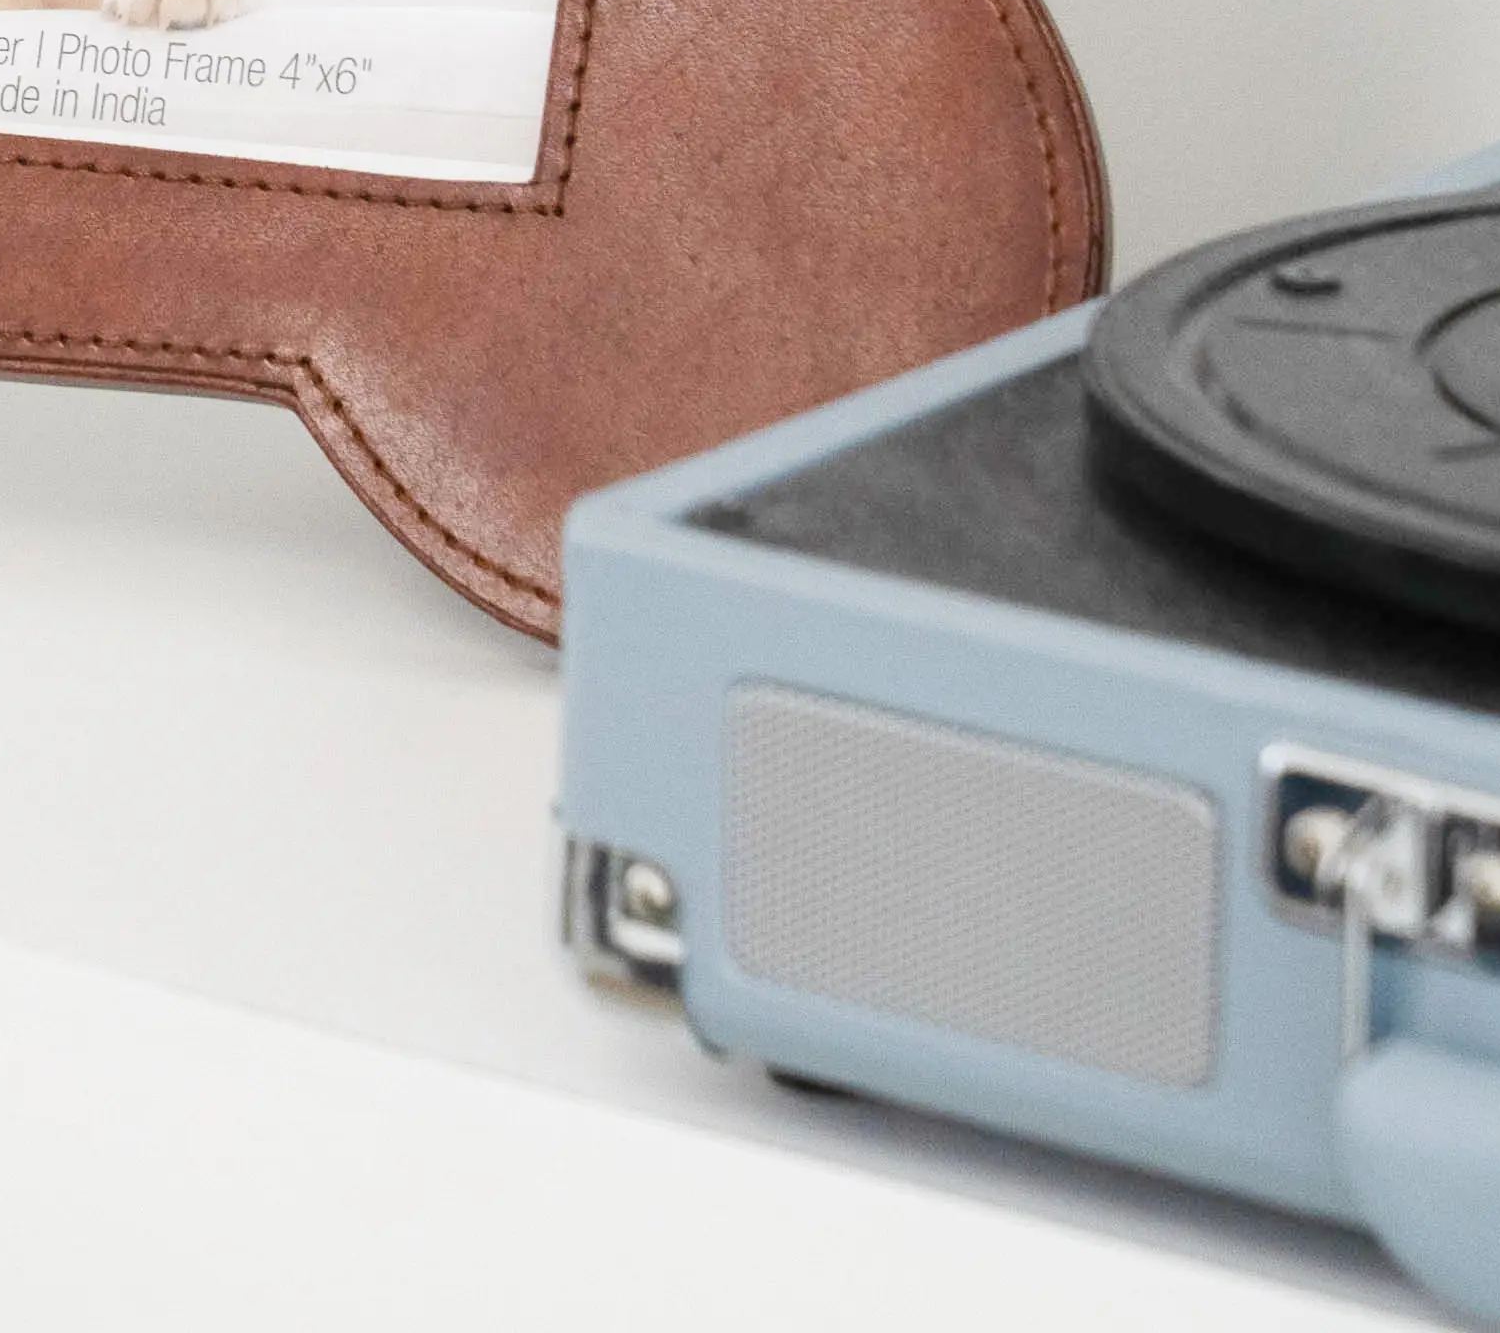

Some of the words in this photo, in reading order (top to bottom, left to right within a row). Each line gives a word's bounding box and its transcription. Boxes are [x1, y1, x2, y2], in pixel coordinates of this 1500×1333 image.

[57, 32, 152, 78] Photo
[163, 41, 267, 88] Frame
[51, 79, 79, 118] in
[91, 82, 167, 127] India
